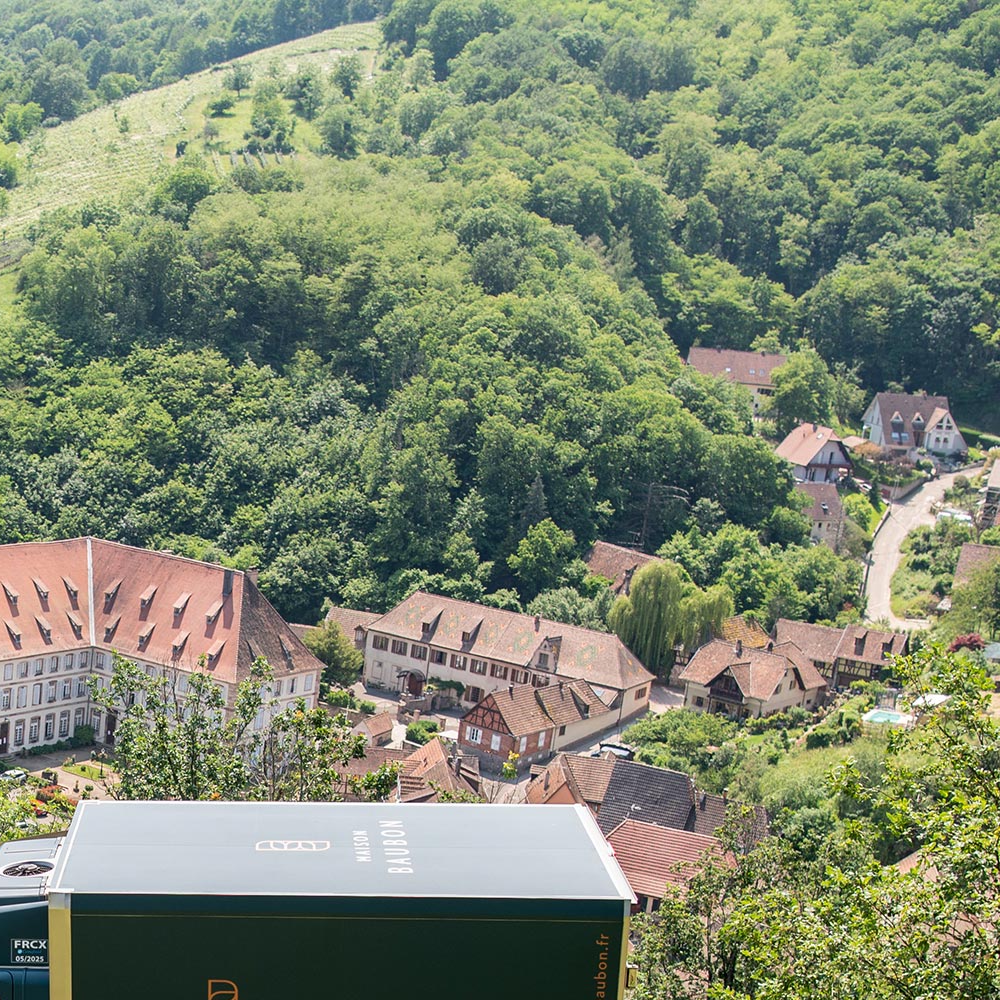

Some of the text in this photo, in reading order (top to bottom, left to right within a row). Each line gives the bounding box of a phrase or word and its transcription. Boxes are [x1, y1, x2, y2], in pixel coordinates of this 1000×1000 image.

[353, 830, 372, 862] MAISON
[379, 820, 414, 874] BAUBON
[14, 940, 47, 949] FRCX
